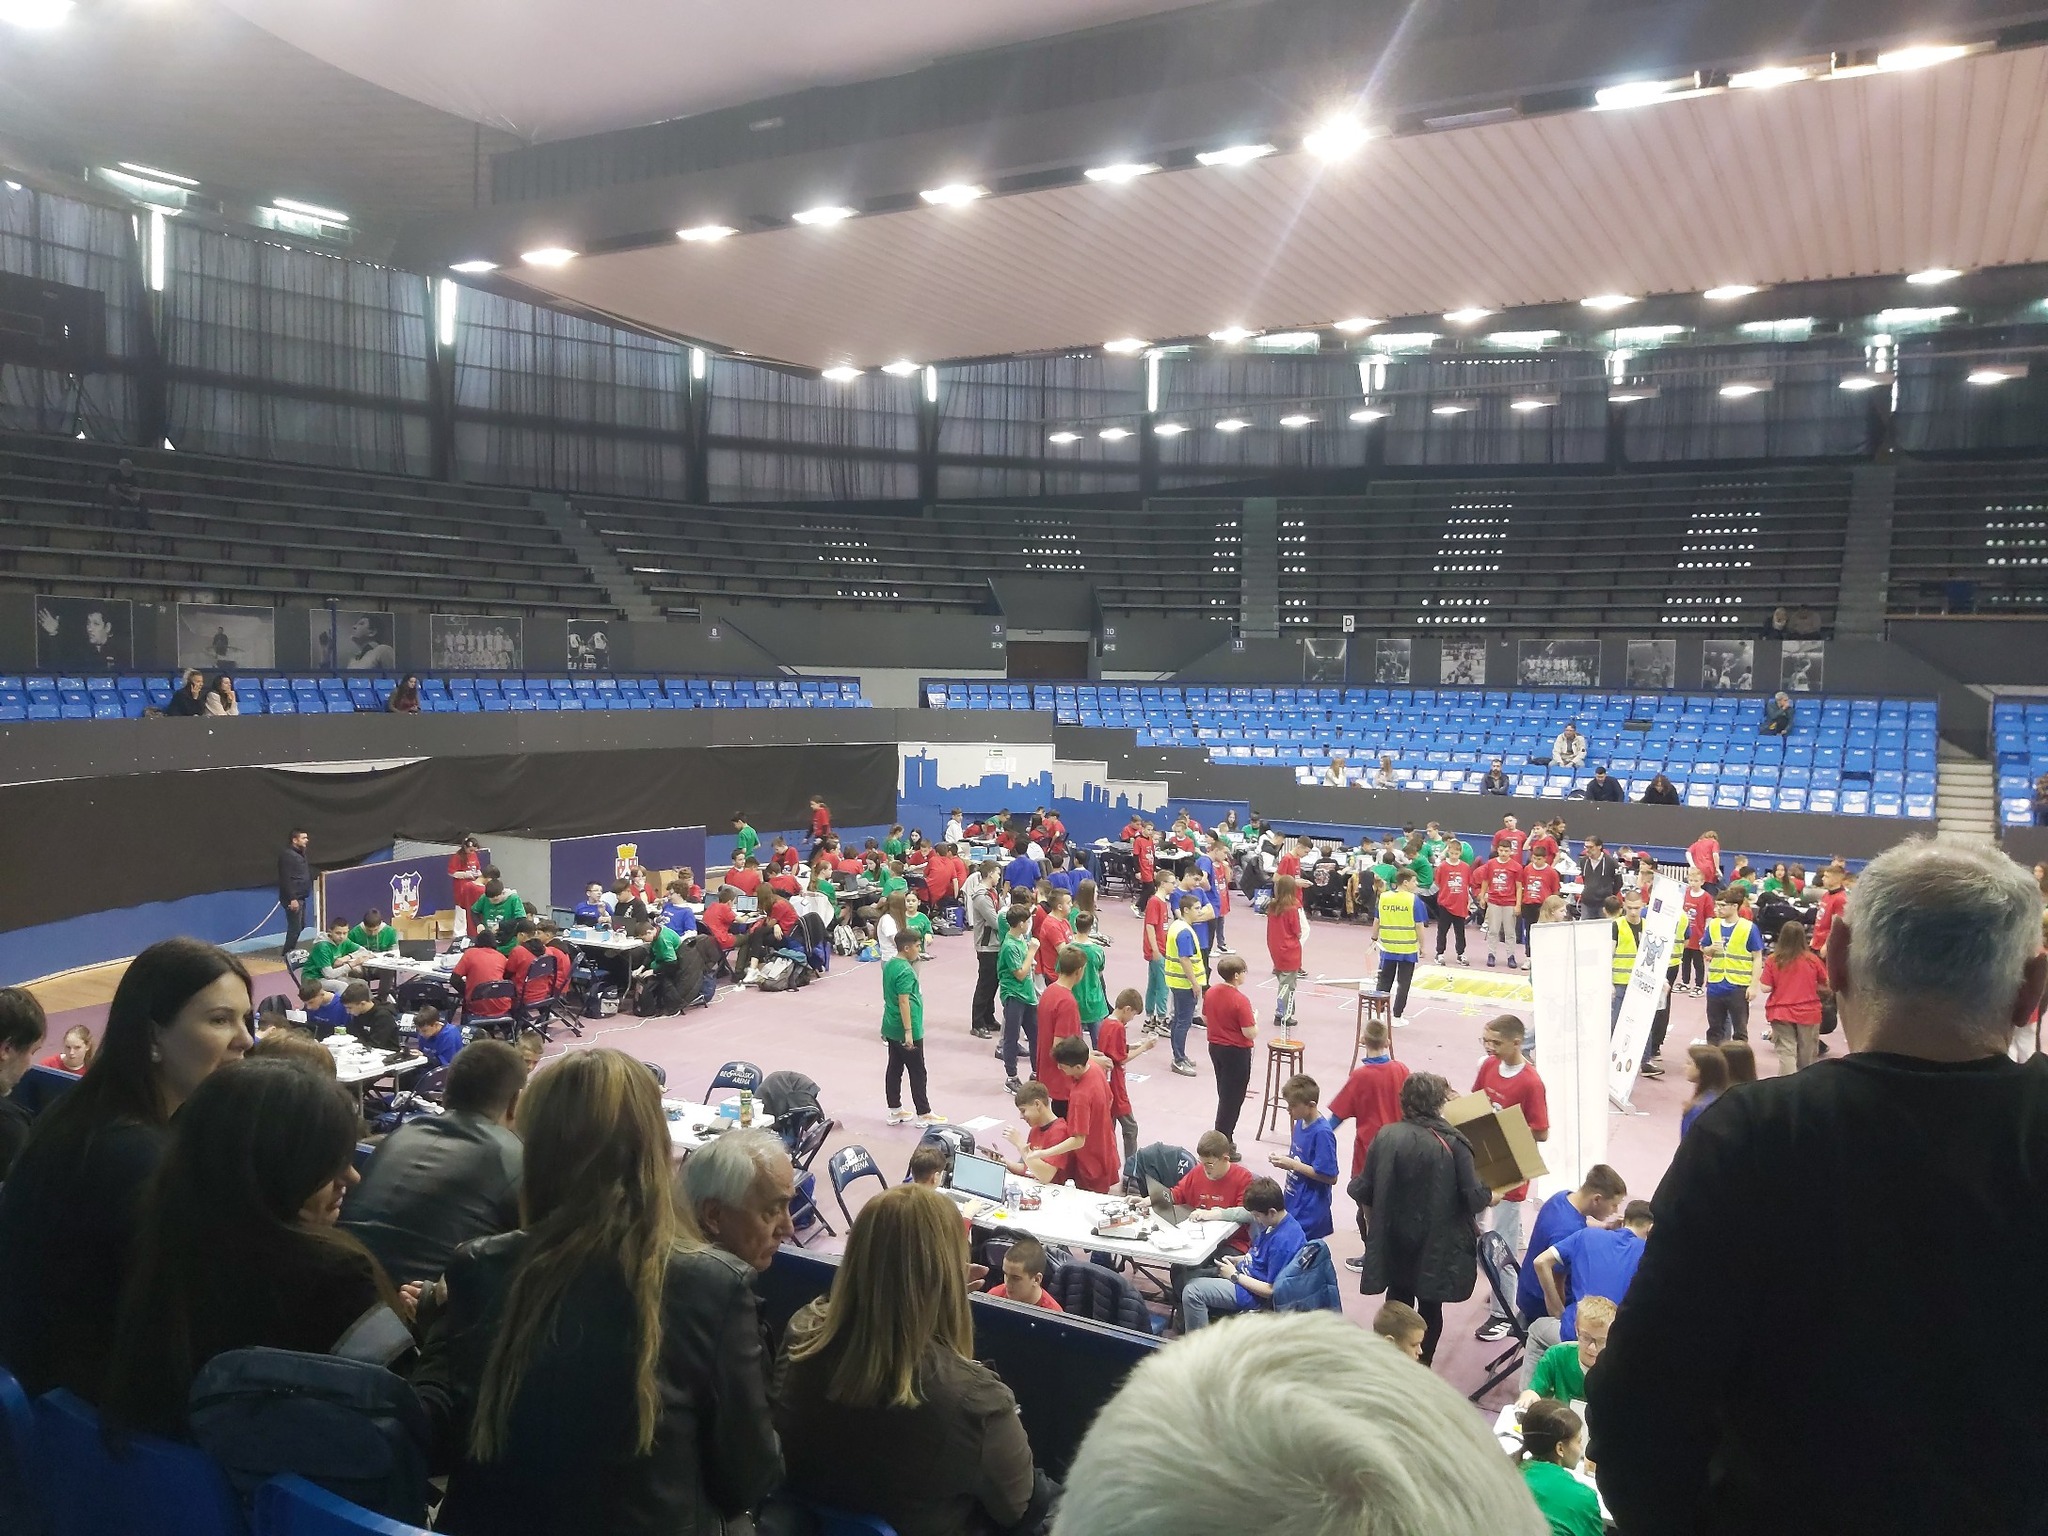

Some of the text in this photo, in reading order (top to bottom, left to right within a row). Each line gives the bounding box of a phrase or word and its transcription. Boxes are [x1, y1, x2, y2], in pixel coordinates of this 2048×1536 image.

[1345, 617, 1353, 627] D
[711, 628, 718, 636] 8
[994, 624, 1001, 633] 9
[1235, 640, 1243, 648] 11
[1381, 904, 1409, 913] СУДИЈА
